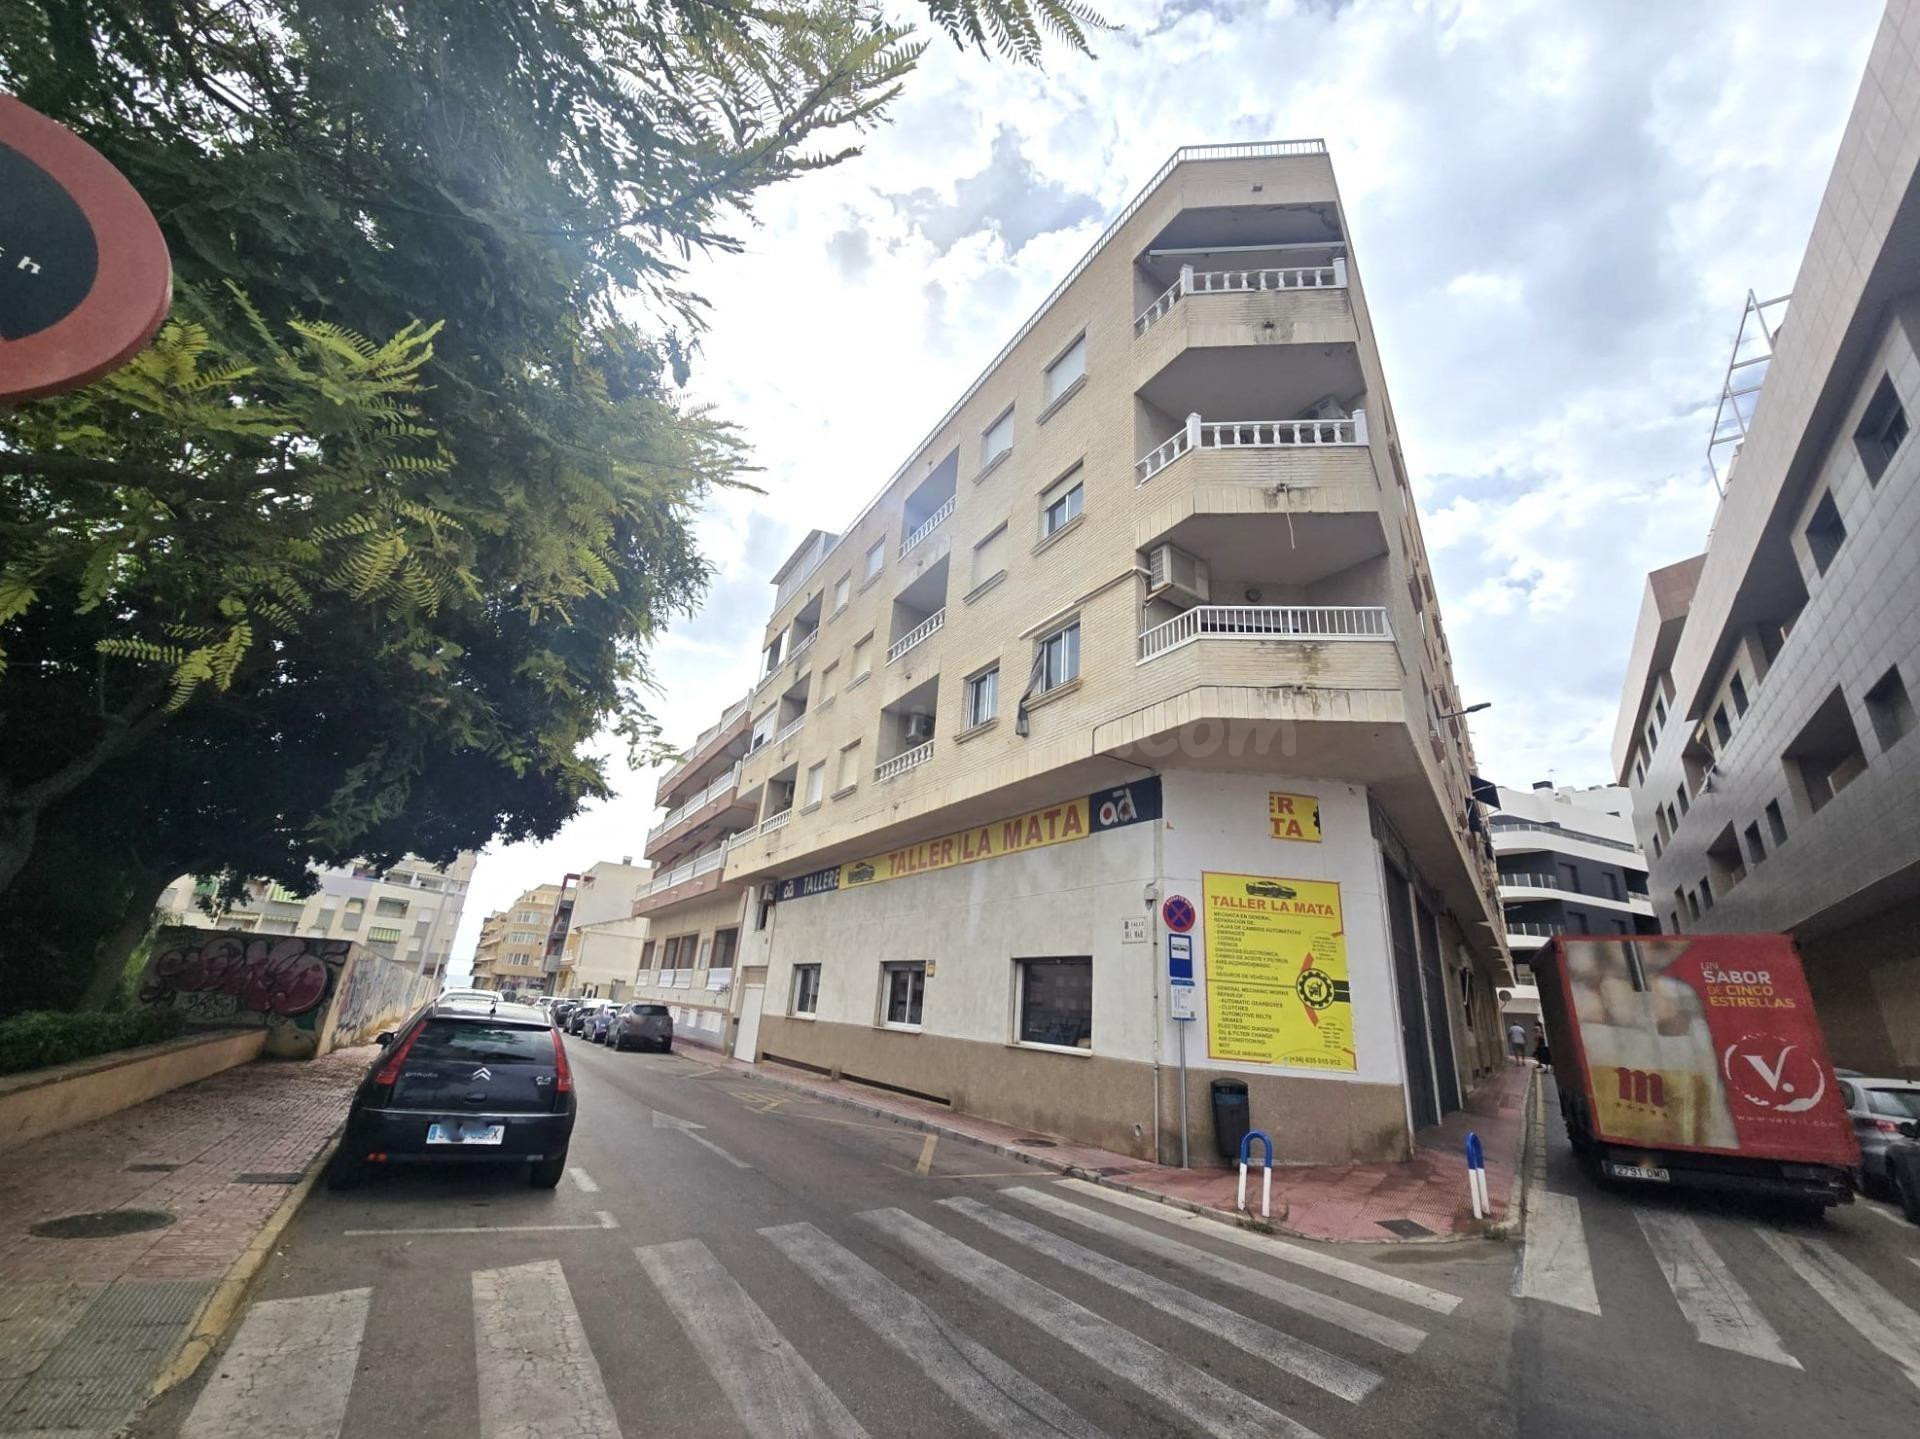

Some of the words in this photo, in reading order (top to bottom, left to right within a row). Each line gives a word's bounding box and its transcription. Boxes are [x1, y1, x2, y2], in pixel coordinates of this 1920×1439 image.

[888, 838, 953, 876] TALLER
[963, 828, 992, 859] LA
[1003, 804, 1083, 850] MATA
[1211, 895, 1266, 910] TALLER
[1271, 900, 1289, 912] LA
[1294, 902, 1334, 916] MATA
[1703, 970, 1772, 985] SABOR
[1725, 985, 1774, 996] CINCO
[1709, 996, 1796, 1008] ESTRELLAS
